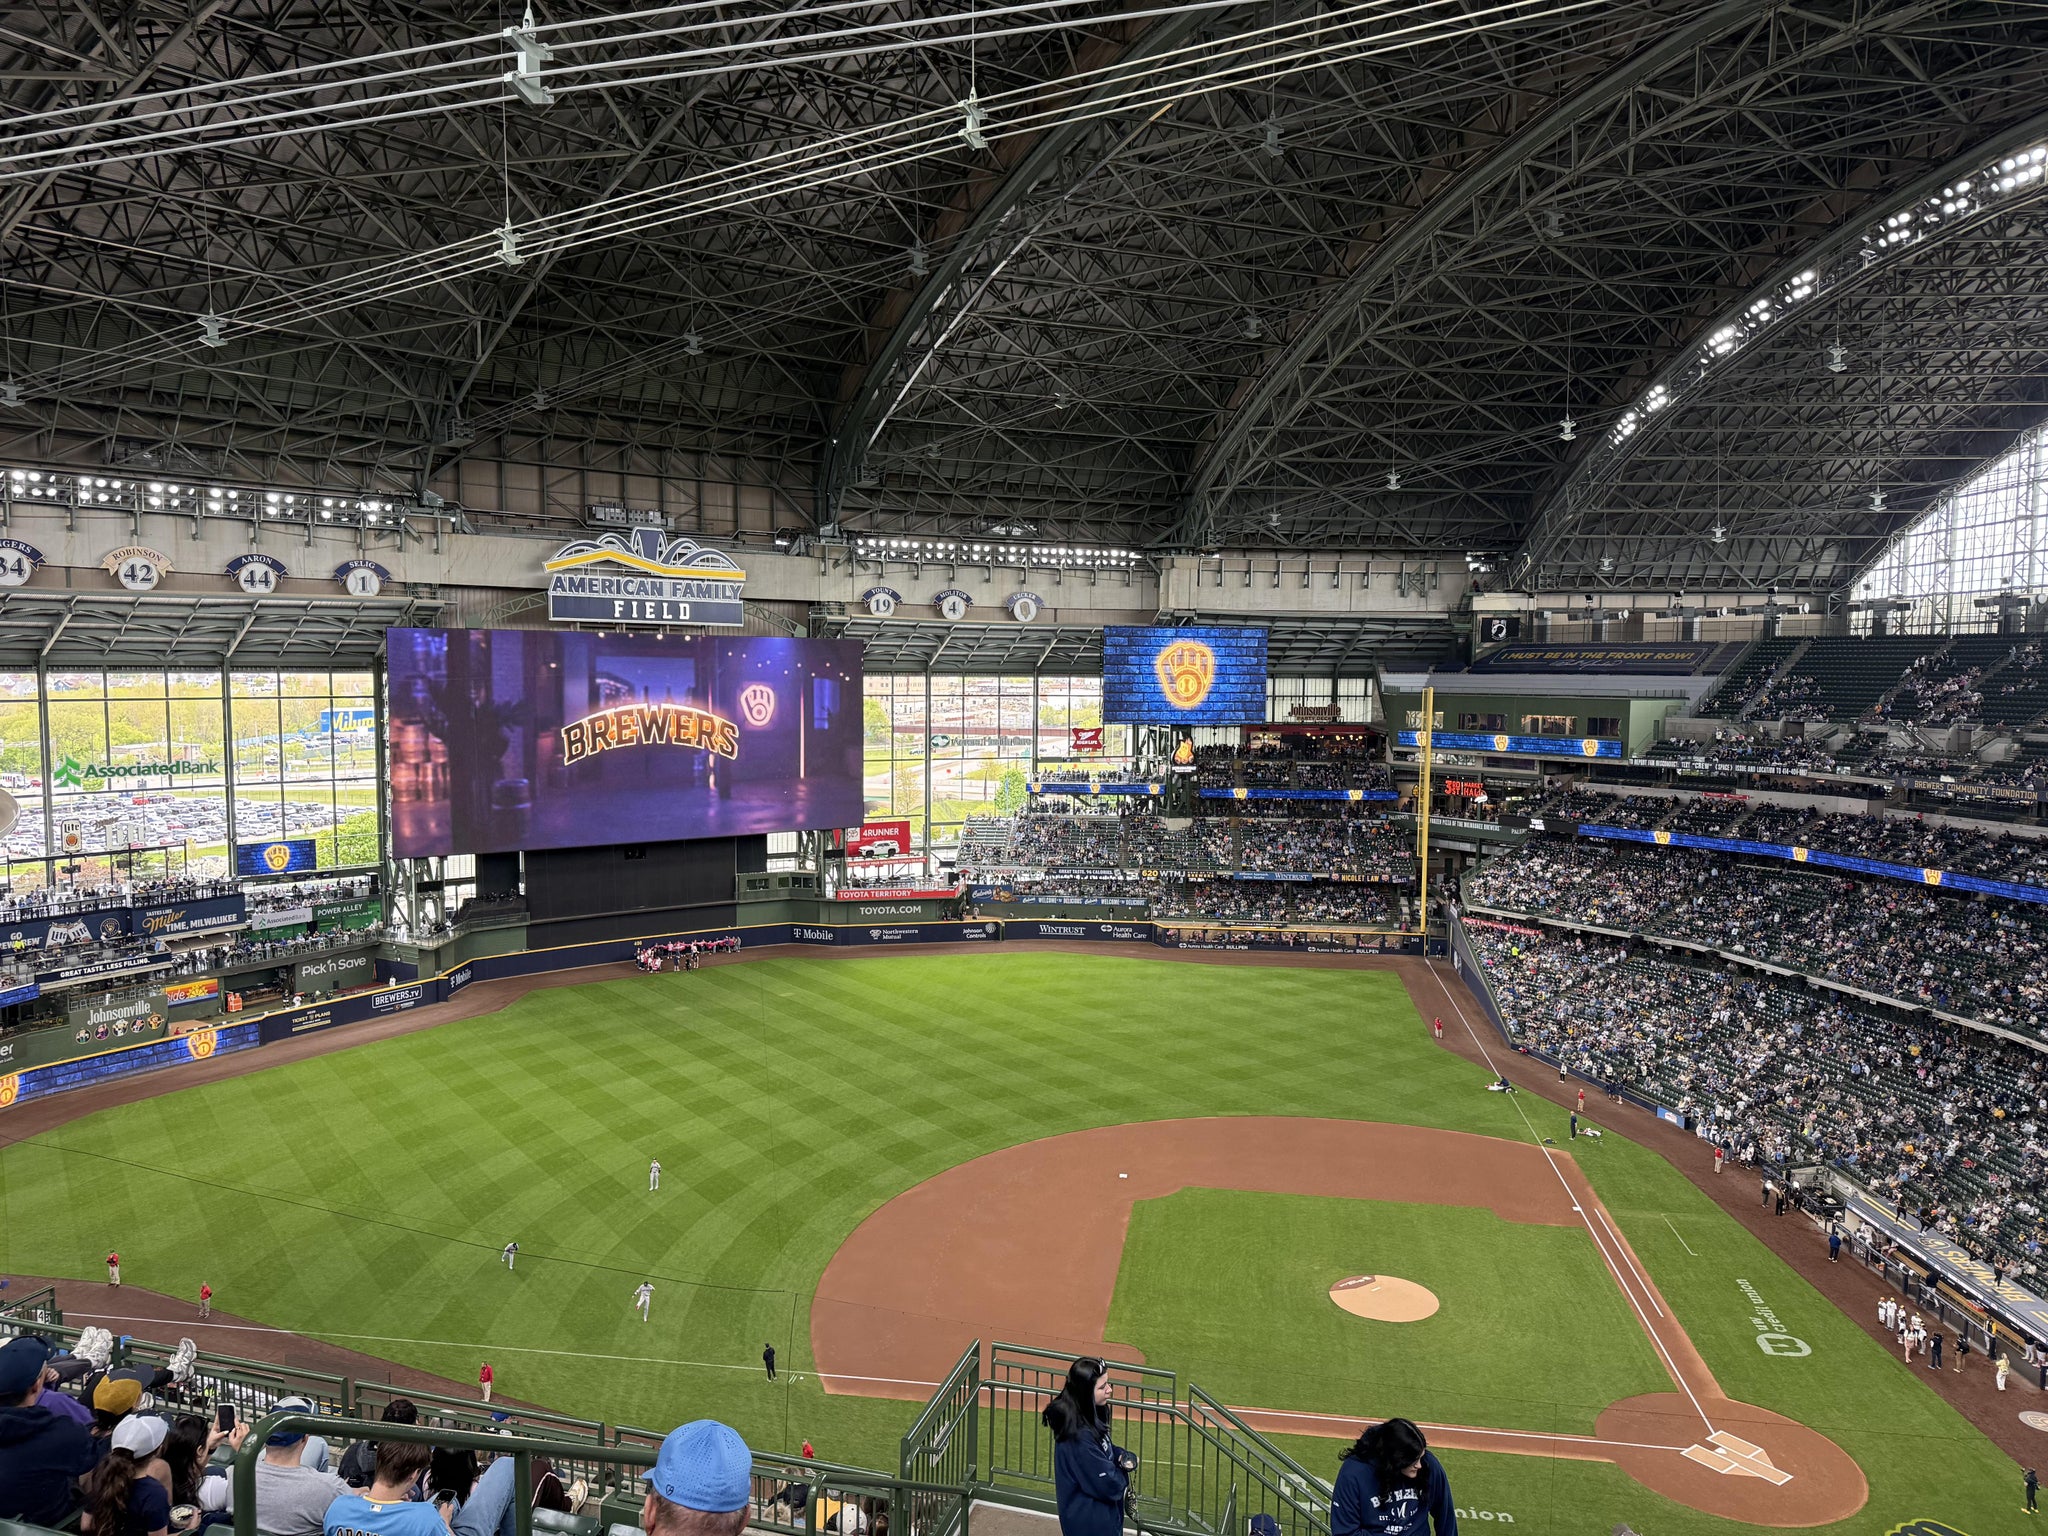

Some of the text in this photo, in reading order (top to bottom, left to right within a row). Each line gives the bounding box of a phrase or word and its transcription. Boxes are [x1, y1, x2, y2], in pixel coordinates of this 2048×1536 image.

[112, 549, 163, 562] ROBINSON
[241, 555, 273, 564] AARON
[349, 560, 376, 569] SELIG
[124, 564, 154, 584] 42
[244, 570, 272, 588] 44
[358, 576, 370, 593] 1
[551, 576, 743, 600] AMERICAN FAMILY
[872, 587, 892, 595] YOUNT
[614, 600, 690, 620] FIELD
[874, 599, 890, 613] 19
[948, 601, 956, 614] 4
[1288, 702, 1342, 716] Johnsonville
[561, 703, 739, 766] BREWERS
[1914, 780, 2038, 800] BREWERS COMMUNITY FOUNDATION
[64, 823, 80, 834] Lite
[862, 828, 899, 837] 4RUNNER
[840, 889, 912, 899] TOYOTA TERRITORY
[318, 907, 341, 917] POWER
[342, 904, 363, 912] ALLEY
[860, 906, 922, 915] TOYOTA.COM
[142, 910, 186, 934] Miller
[166, 914, 238, 932] TIME, MILWAUKEE
[1040, 924, 1086, 934] WINTRUST
[10, 932, 22, 940] GO
[804, 929, 834, 940] Mobile
[60, 958, 150, 978] GREAT TASTE. LESS FILLING.
[302, 964, 326, 977] Pick
[338, 957, 367, 970] Save
[456, 968, 471, 986] Mobile
[87, 1002, 151, 1026] Johnsonville
[1754, 1306, 1788, 1332] credit
